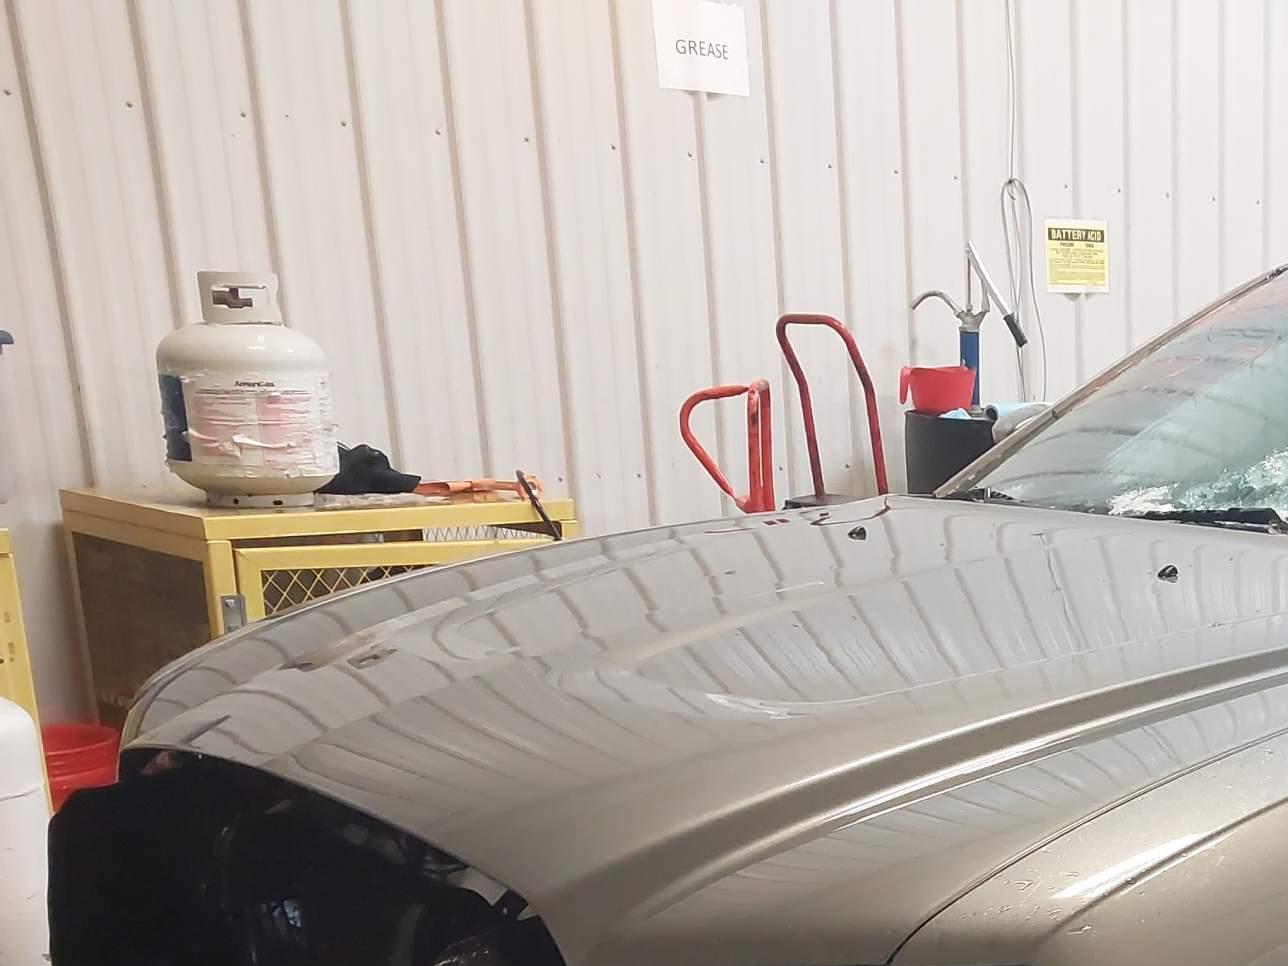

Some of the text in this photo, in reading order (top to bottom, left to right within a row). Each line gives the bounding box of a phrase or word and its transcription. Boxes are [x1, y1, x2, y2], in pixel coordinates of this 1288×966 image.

[675, 39, 729, 60] GREASE
[1051, 229, 1102, 241] BATTERY ACID
